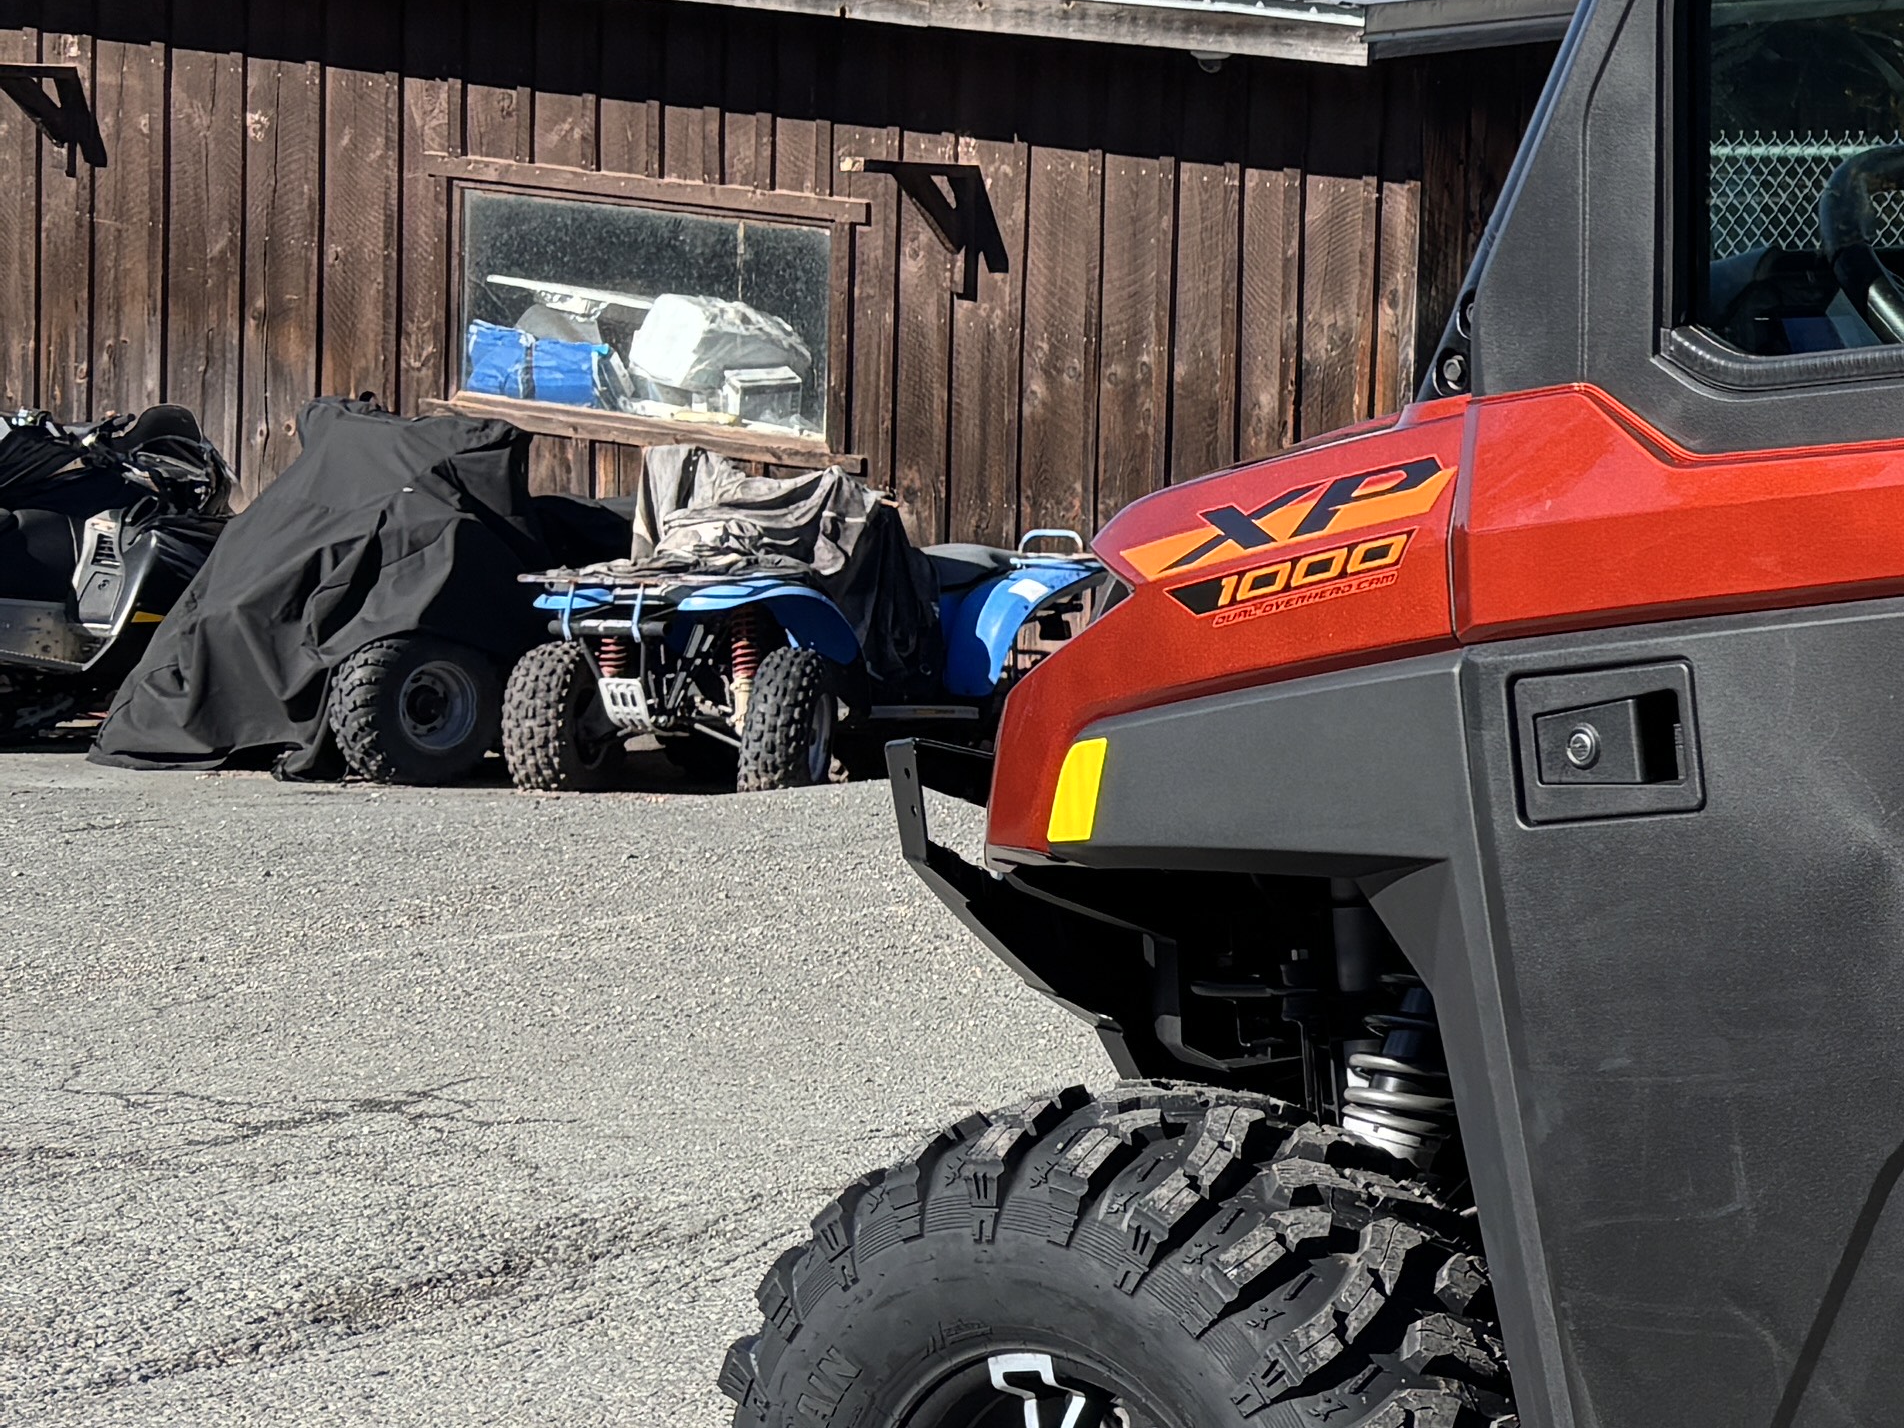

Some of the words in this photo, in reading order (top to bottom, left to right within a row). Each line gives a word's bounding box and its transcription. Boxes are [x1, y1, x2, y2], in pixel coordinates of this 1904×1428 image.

[1158, 456, 1443, 572] XP
[1215, 606, 1257, 625] DUAL
[1261, 584, 1352, 615] OVERHEAD
[1352, 573, 1397, 592] CAM
[1217, 533, 1408, 607] 1000
